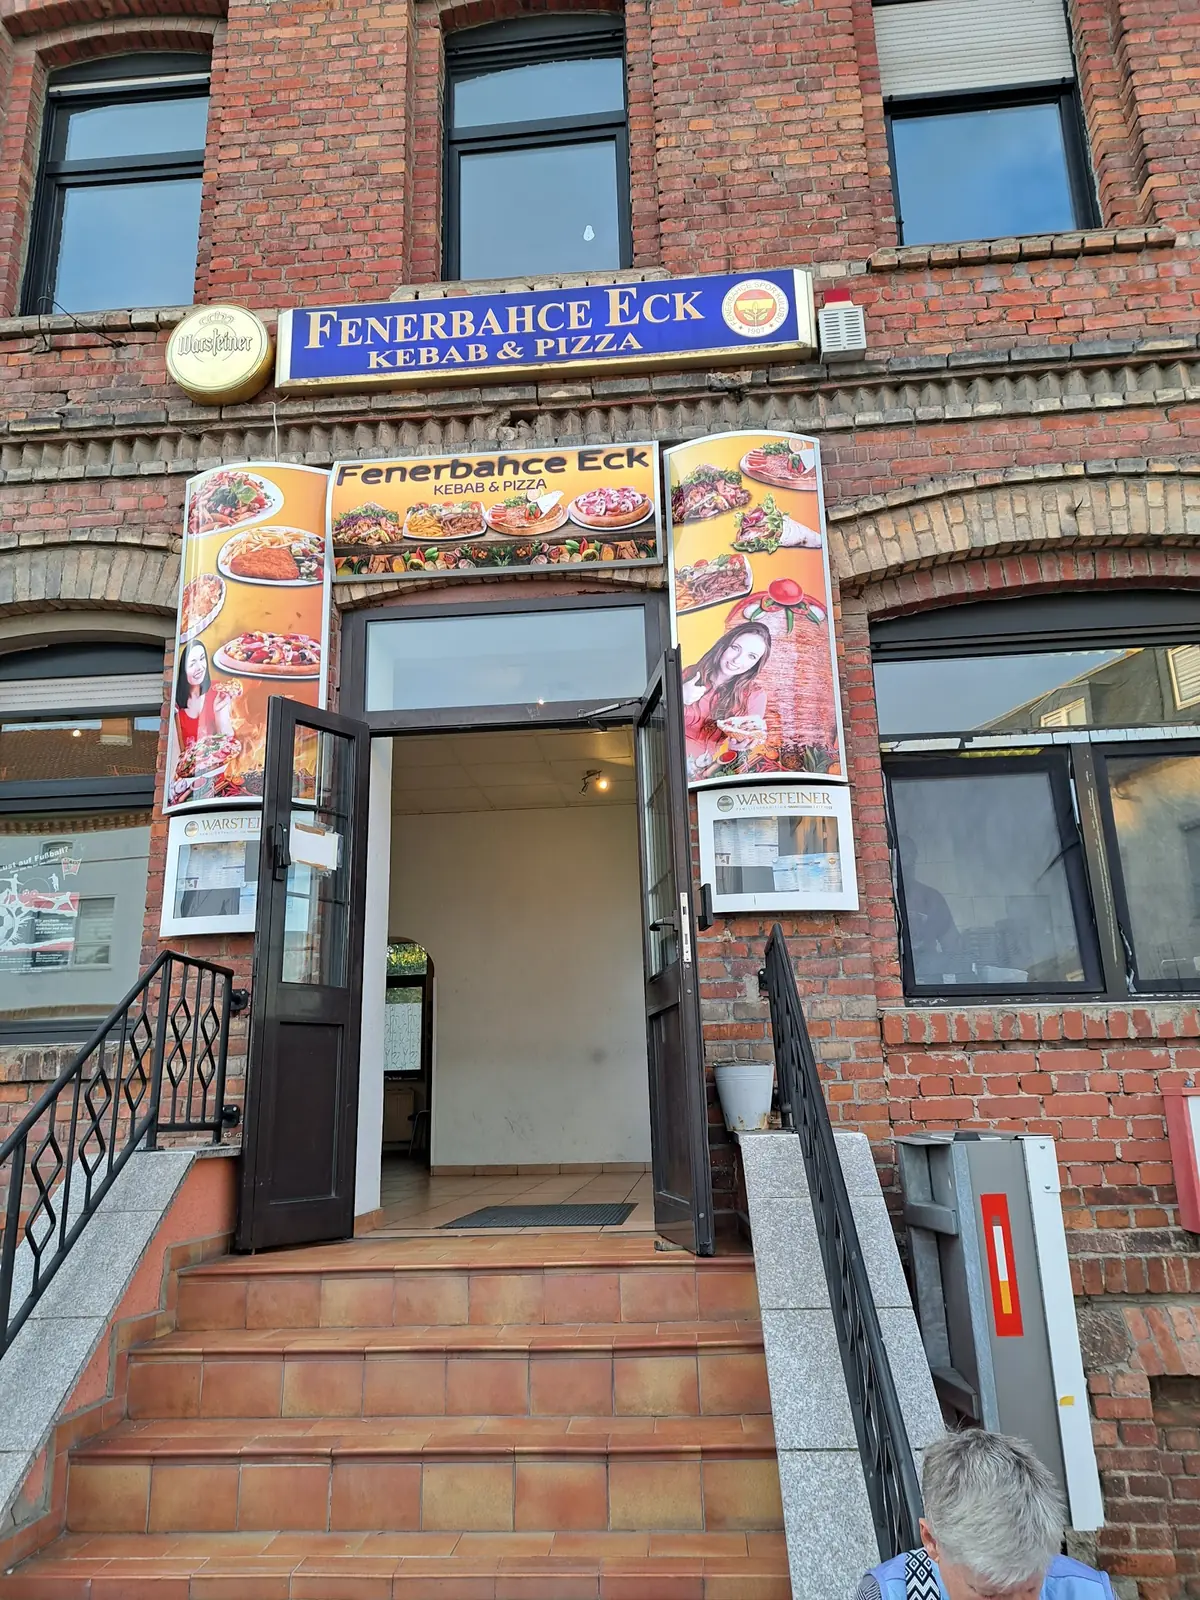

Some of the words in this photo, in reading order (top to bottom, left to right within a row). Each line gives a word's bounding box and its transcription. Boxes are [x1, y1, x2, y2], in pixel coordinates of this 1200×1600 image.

[304, 300, 593, 349] FENERBAHCE
[604, 287, 705, 327] ECK
[178, 328, 254, 357] Warsteiner
[367, 343, 489, 369] KEBAB
[496, 341, 525, 360] &
[534, 332, 643, 357] PIZZA
[336, 456, 567, 486] Fenerbahce
[577, 448, 649, 471] Eck
[434, 482, 485, 496] KEBAB
[488, 481, 499, 493] &
[503, 478, 547, 491] PIZZA
[736, 792, 832, 805] WARSTEINER
[18, 857, 32, 866] auf
[34, 846, 69, 862] Fußball?
